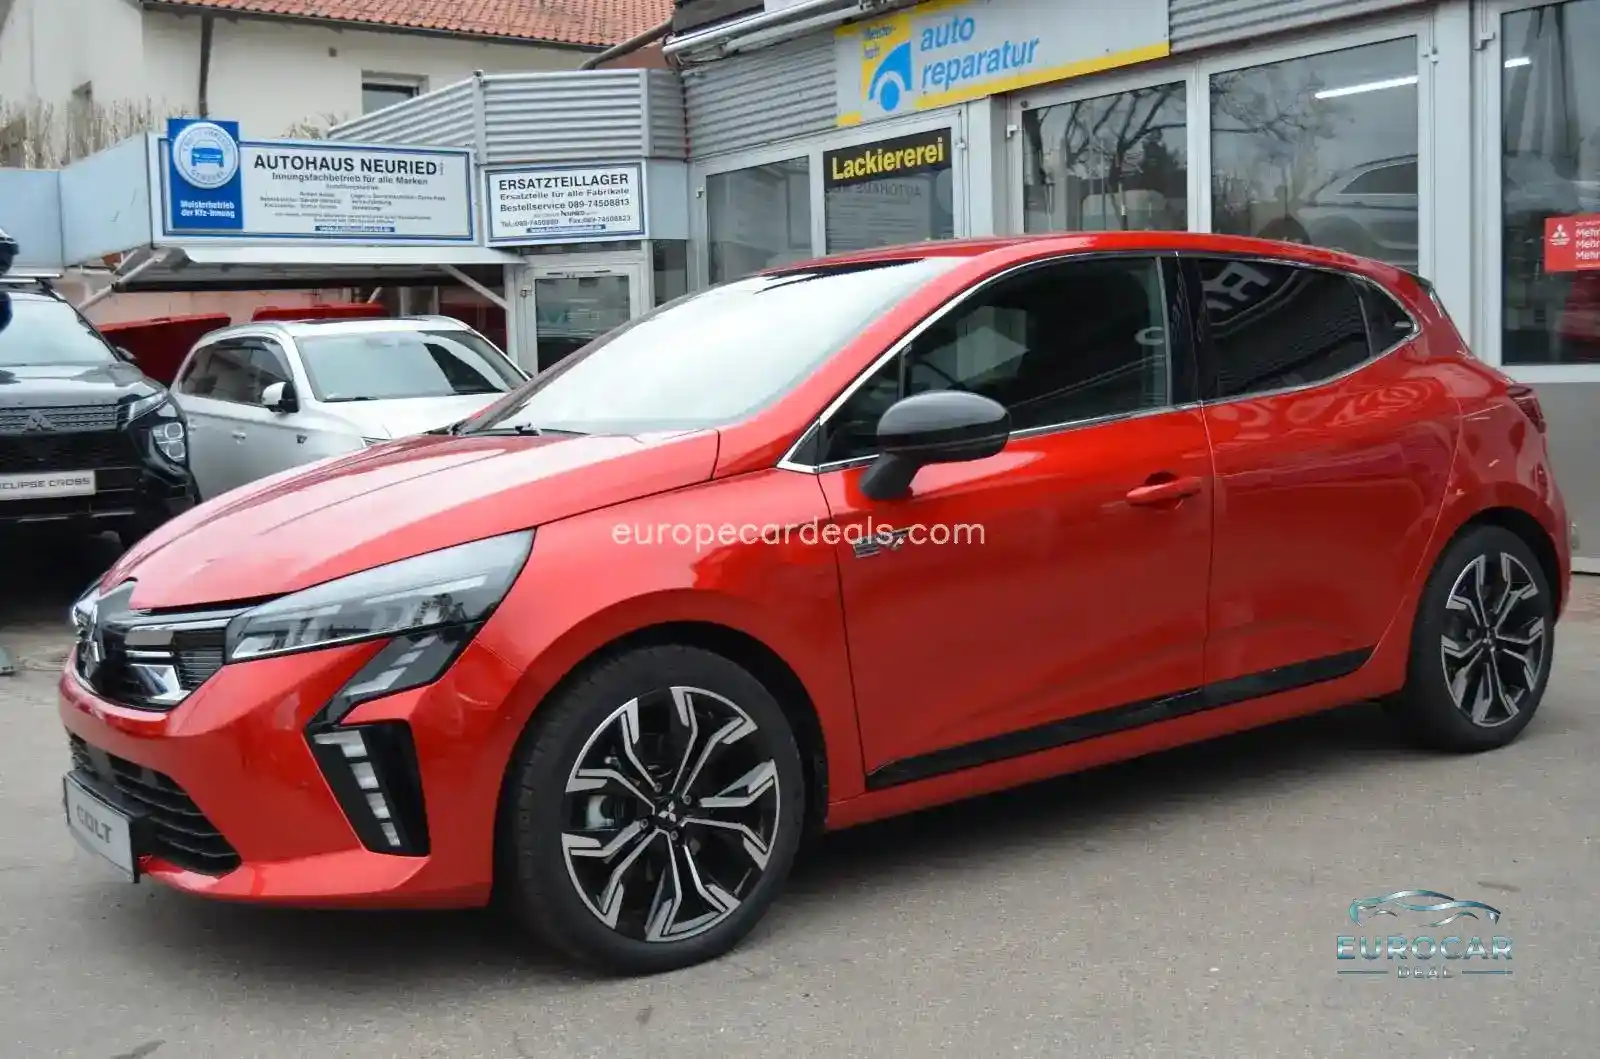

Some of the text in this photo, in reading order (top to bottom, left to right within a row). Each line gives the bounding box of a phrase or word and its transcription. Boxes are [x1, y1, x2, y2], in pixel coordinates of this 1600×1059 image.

[920, 15, 975, 51] auto
[922, 38, 1040, 91] reparatur
[254, 154, 355, 172] AUTOHAUS
[360, 158, 437, 175] NEURIED
[832, 137, 944, 180] Lackiererei
[272, 172, 428, 185] Innungsfachbetrieb für alle Marken
[499, 173, 629, 191] ERSATZTEILLAGER
[500, 187, 630, 201] Ersatzteile für alle Fabrikate
[500, 202, 566, 212] Bestellservice
[0, 479, 46, 490] CLIPSE
[76, 804, 113, 843] COLT
